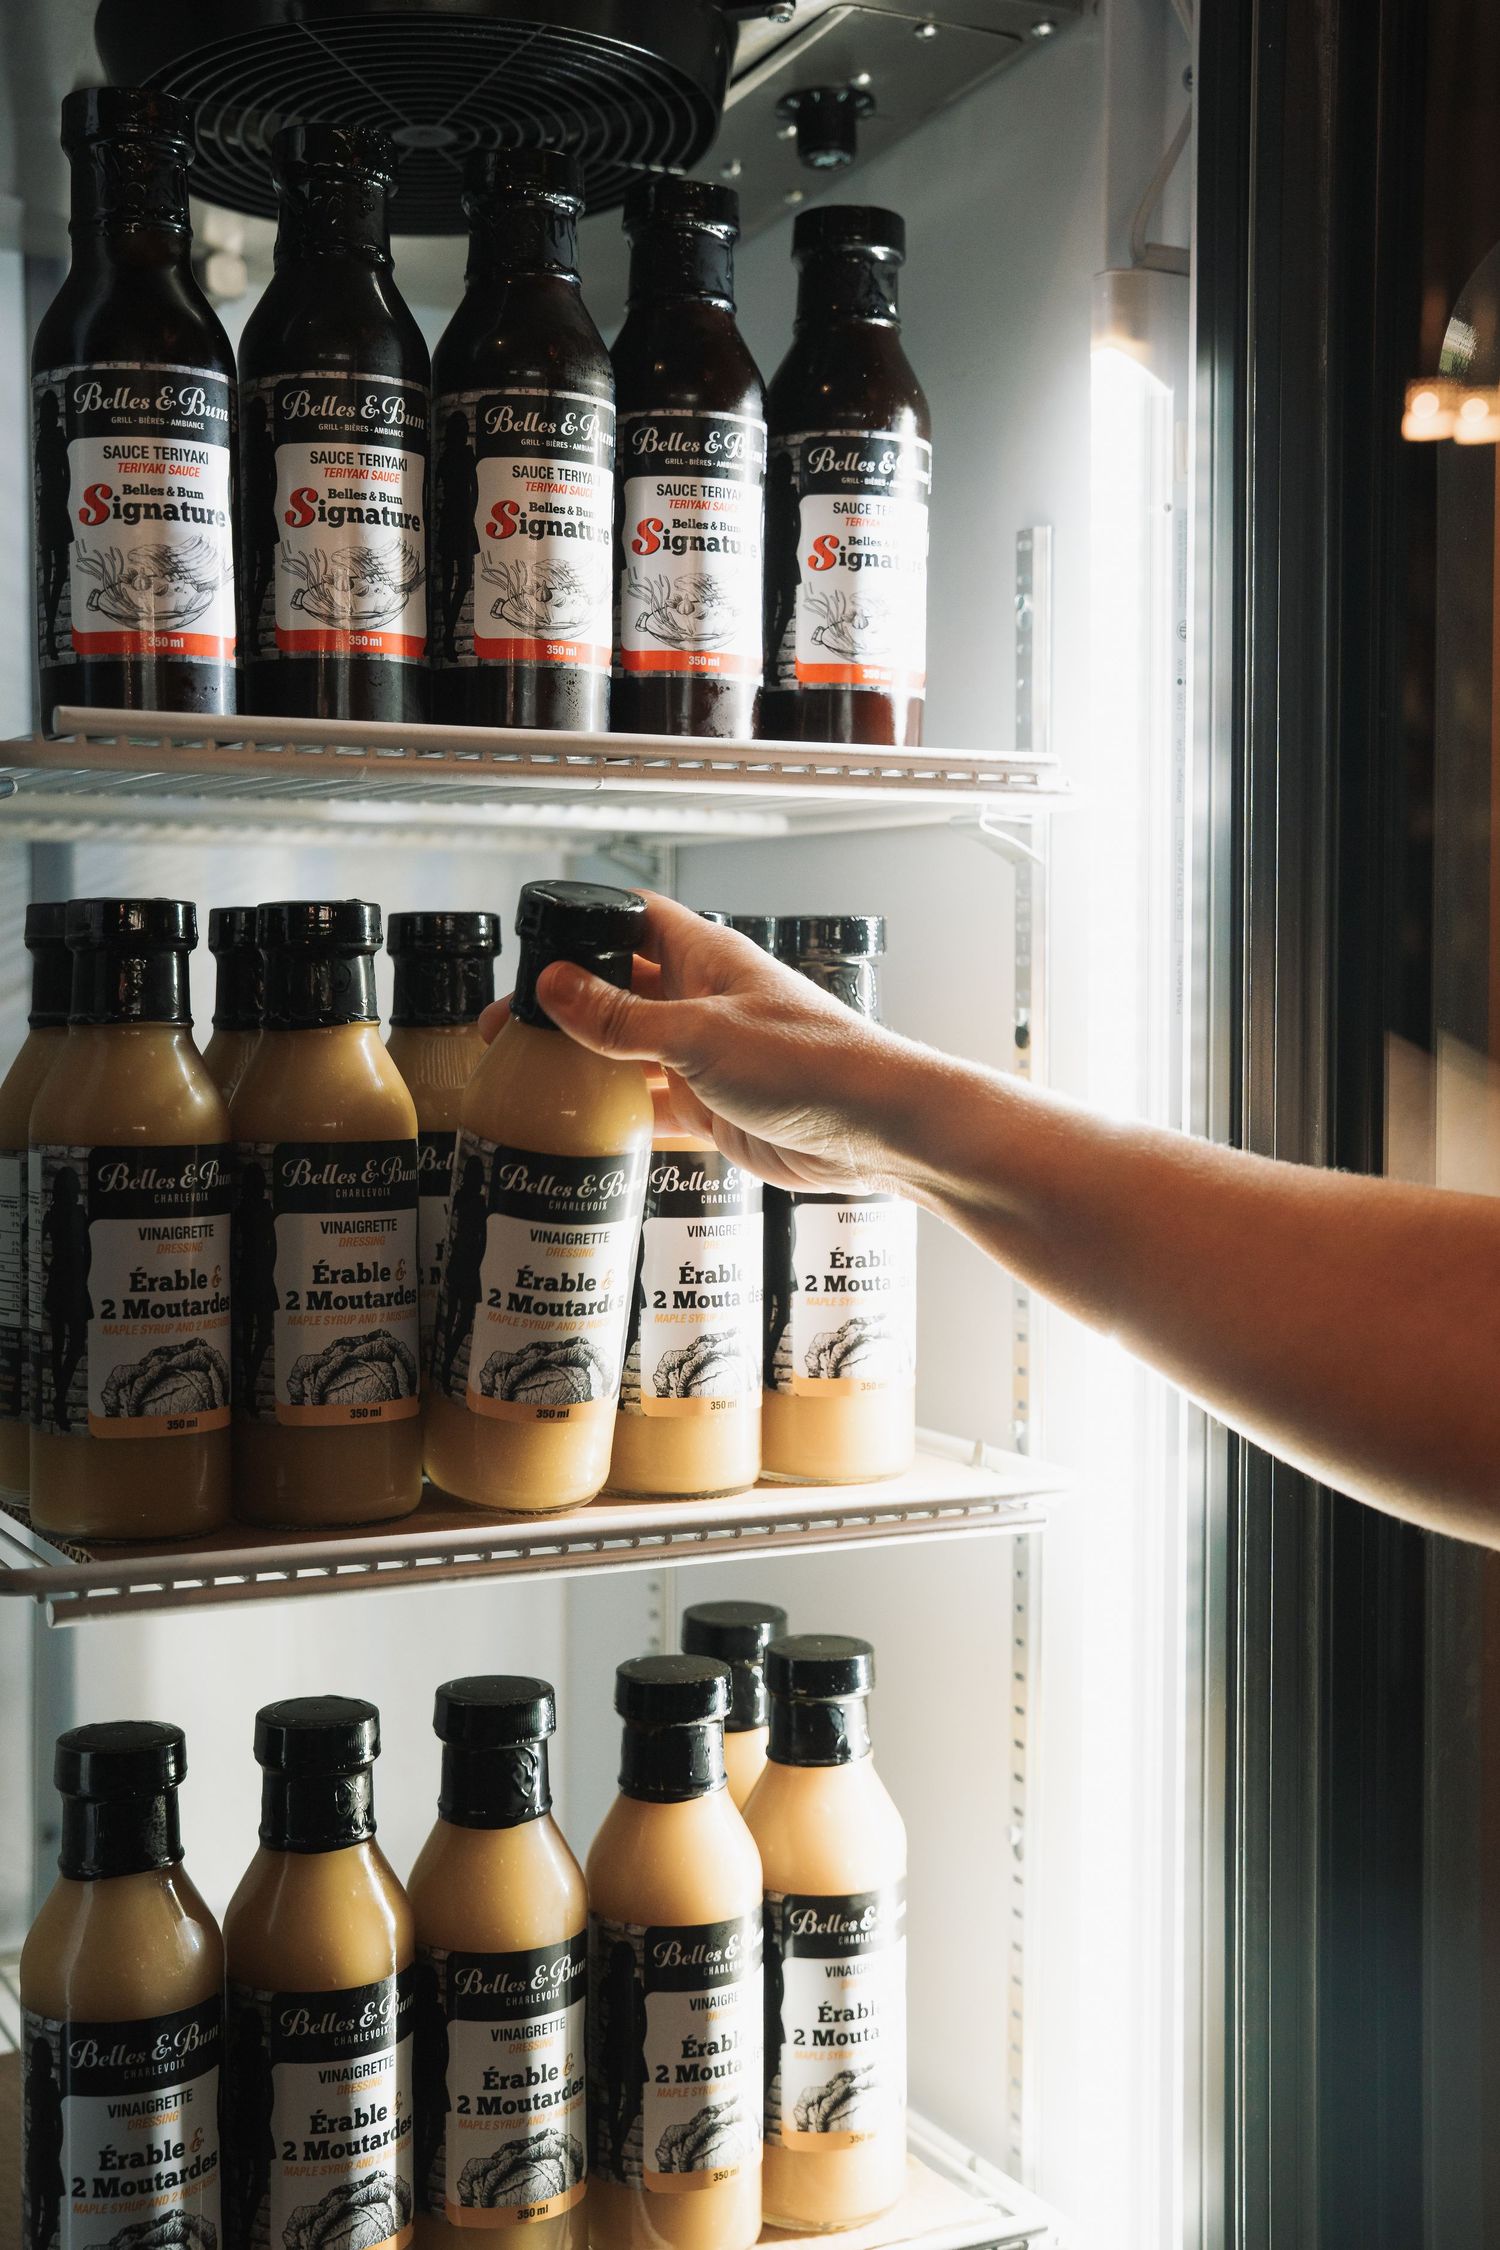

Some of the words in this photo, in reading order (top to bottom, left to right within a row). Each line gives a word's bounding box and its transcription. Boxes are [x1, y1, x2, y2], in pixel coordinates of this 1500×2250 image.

[73, 382, 150, 414] Belles
[155, 386, 176, 411] &
[179, 387, 228, 422] Bum
[282, 389, 355, 420] Belles
[361, 395, 379, 419] &
[381, 396, 424, 429] Bum
[112, 417, 132, 425] GRILL
[138, 416, 164, 425] BIÈRES
[171, 419, 204, 430] AMBIANCE
[485, 405, 557, 434] Belles
[561, 413, 578, 435] &
[319, 423, 339, 431] GRILL
[345, 423, 369, 432] BIÈRES
[374, 426, 404, 438] AMBIANCE
[546, 439, 568, 448] BIÈRES
[632, 426, 700, 456] Belles
[704, 431, 722, 453] &
[103, 445, 149, 459] SAUCE
[153, 446, 209, 465] TERIYAKI
[310, 451, 354, 464] SAUCE
[357, 452, 407, 471] TERIYAKI
[808, 446, 875, 474] Belles
[117, 462, 166, 474] TERIYAKI
[169, 464, 200, 478] SAUCE
[324, 467, 369, 480] TERIYAKI
[371, 470, 400, 483] SAUCE
[512, 465, 554, 478] SAUCE
[122, 484, 164, 496] Belles
[166, 486, 175, 496] &
[177, 487, 204, 500] Bum
[525, 481, 567, 493] TERIYAKI
[657, 484, 697, 497] SAUCE
[79, 483, 226, 527] Signature
[328, 489, 367, 500] Belles
[369, 491, 377, 501] &
[379, 492, 403, 505] Bum
[669, 500, 710, 509] TERIYAKI
[285, 487, 420, 532] Signature
[529, 502, 566, 514] Belles
[567, 506, 574, 515] &
[833, 502, 871, 514] SAUCE
[672, 519, 708, 530] Belles
[710, 522, 717, 530] &
[848, 537, 881, 546] Belles
[148, 637, 169, 647] 350
[171, 638, 184, 648] ml
[349, 634, 368, 645] 350
[370, 636, 382, 646] ml
[547, 644, 564, 655] 350
[566, 645, 576, 656] ml
[689, 655, 706, 665] 350
[708, 657, 720, 667] ml
[97, 1162, 175, 1192] Belles
[180, 1164, 198, 1190] &
[282, 1158, 356, 1187] Belles
[361, 1160, 379, 1184] &
[381, 1157, 416, 1184] Bum
[500, 1163, 572, 1197] Belles
[577, 1174, 596, 1198] &
[652, 1166, 719, 1193] Belles
[154, 1191, 208, 1203] CHARLEVOIX
[336, 1188, 390, 1198] CHARLEVOIX
[549, 1200, 607, 1211] CHARLEVOIX
[138, 1224, 214, 1241] VINAIGRETTE
[320, 1218, 397, 1234] VINAIGRETTE
[338, 1236, 385, 1248] DRESSING
[530, 1229, 610, 1245] VINAIGRETTE
[157, 1242, 203, 1254] DRESSING
[545, 1247, 594, 1258] DRESSING
[129, 1267, 208, 1293] Érable
[312, 1261, 391, 1284] Érable
[515, 1265, 596, 1292] Érable
[805, 1275, 817, 1291] 2
[101, 1300, 116, 1319] 2
[123, 1292, 230, 1319] Moutardes
[286, 1291, 300, 1310] 2
[306, 1285, 416, 1311] Moutardes
[487, 1288, 501, 1307] 2
[653, 1291, 667, 1309] 2
[806, 1297, 837, 1306] MAPLE
[287, 1315, 320, 1326] MAPLE
[323, 1315, 356, 1326] SYRUP
[358, 1313, 376, 1324] AND
[487, 1311, 519, 1327] MAPLE
[522, 1318, 555, 1331] SYRUP
[558, 1321, 576, 1331] AND
[655, 1312, 686, 1324] MAPLE
[102, 1322, 139, 1336] MAPLE
[141, 1323, 174, 1335] SYRUP
[176, 1322, 193, 1332] AND
[350, 1408, 368, 1419] 350
[370, 1406, 381, 1418] ml
[536, 1409, 555, 1419] 350
[557, 1409, 569, 1419] ml
[711, 1401, 726, 1411] 350
[167, 1419, 185, 1430] 350
[187, 1418, 197, 1428] ml
[790, 1909, 857, 1936] Belles
[653, 1941, 721, 1968] Belles
[454, 1968, 526, 1996] Belles
[530, 1965, 548, 1990] &
[550, 1954, 586, 1988] Bum
[506, 1988, 560, 2007] CHARLEVOIX
[280, 2008, 354, 2037] Belles
[359, 2001, 377, 2027] &
[334, 2026, 390, 2047] CHARLEVOIX
[490, 2016, 566, 2042] VINAIGRETTE
[794, 2029, 805, 2045] 2
[69, 2039, 146, 2069] Belles
[151, 2034, 171, 2061] &
[174, 2021, 219, 2057] Bum
[509, 2036, 554, 2054] DRESSING
[124, 2059, 185, 2080] CHARLEVOIX
[319, 2054, 394, 2084] VINAIGRETTE
[482, 2063, 558, 2091] Érable
[655, 2065, 670, 2083] 2
[337, 2076, 382, 2096] DRESSING
[657, 2087, 688, 2098] MAPLE
[108, 2089, 193, 2119] VINAIGRETTE
[457, 2095, 470, 2114] 2
[476, 2076, 584, 2116] Moutardes
[128, 2111, 179, 2131] DRESSING
[310, 2104, 387, 2135] Érable
[458, 2118, 491, 2129] MAPLE
[493, 2118, 524, 2130] SYRUP
[282, 2141, 297, 2161] 2
[303, 2113, 412, 2161] Moutardes
[99, 2139, 185, 2171] Érable
[72, 2178, 86, 2197] 2
[93, 2151, 217, 2198] Moutardes
[284, 2164, 318, 2177] MAPLE
[320, 2163, 353, 2176] SYRUP
[356, 2158, 373, 2171] AND
[714, 2170, 728, 2182] 350
[73, 2201, 109, 2214] MAPLE
[111, 2199, 146, 2213] SYRUP
[148, 2196, 169, 2207] AND
[172, 2194, 178, 2203] 2
[518, 2206, 535, 2220] 350
[537, 2204, 549, 2216] ml
